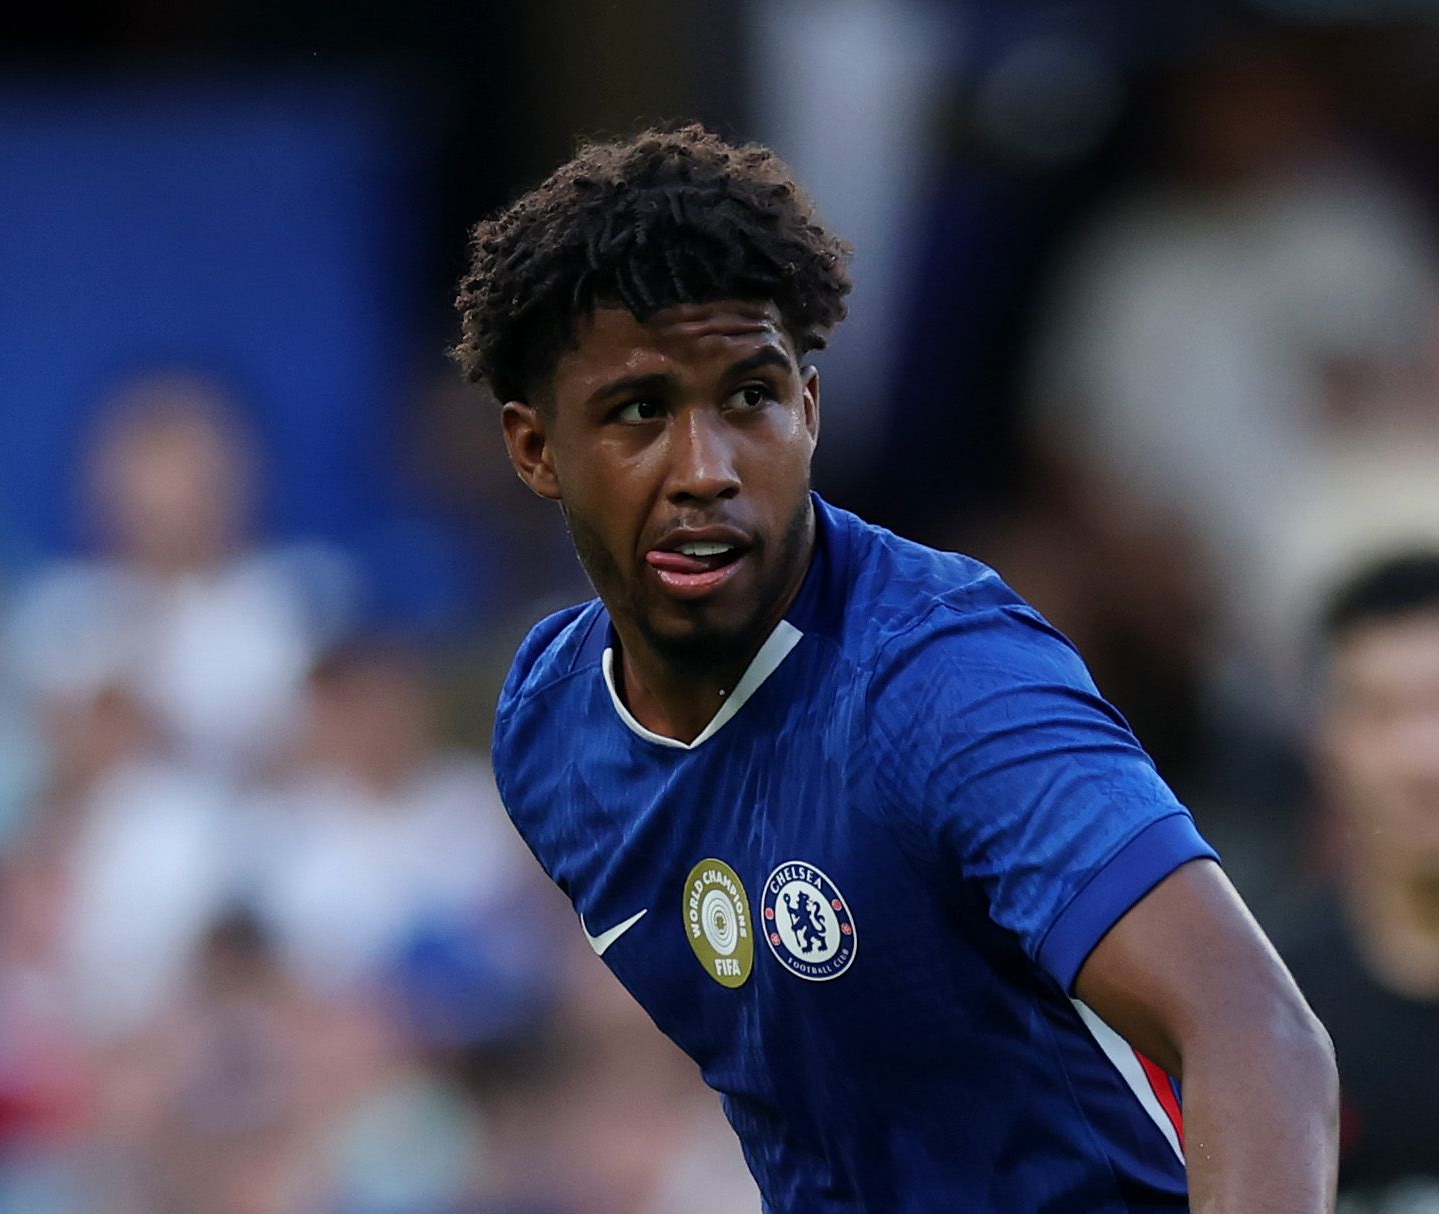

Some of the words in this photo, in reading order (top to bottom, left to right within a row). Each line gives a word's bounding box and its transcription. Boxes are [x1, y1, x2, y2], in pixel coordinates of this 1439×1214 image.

[769, 866, 823, 895] CHELSEA
[689, 879, 704, 939] WORLD
[702, 869, 748, 939] CHAMPIONS
[714, 958, 742, 977] FIFA
[787, 956, 833, 975] FOOTBALL
[833, 948, 850, 969] CLUB
